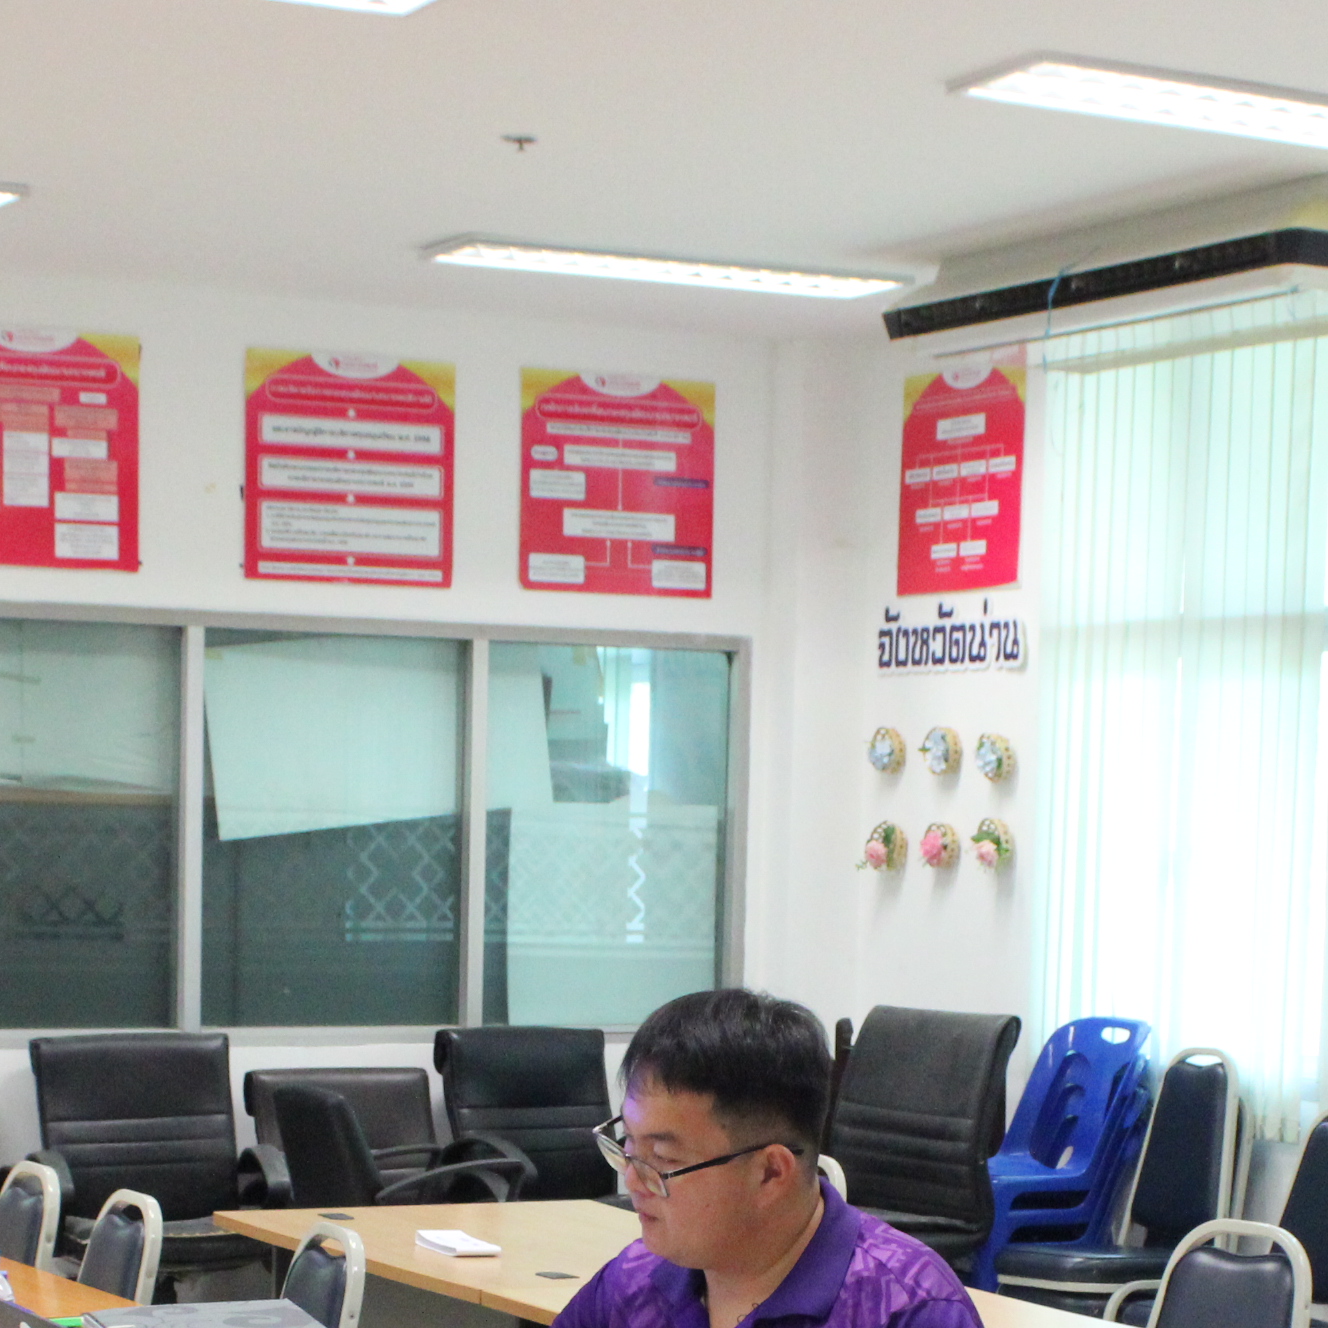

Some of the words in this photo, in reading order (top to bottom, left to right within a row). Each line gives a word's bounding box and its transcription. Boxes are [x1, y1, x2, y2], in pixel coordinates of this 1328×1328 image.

[878, 597, 1020, 669] จังหวัดน่าน
